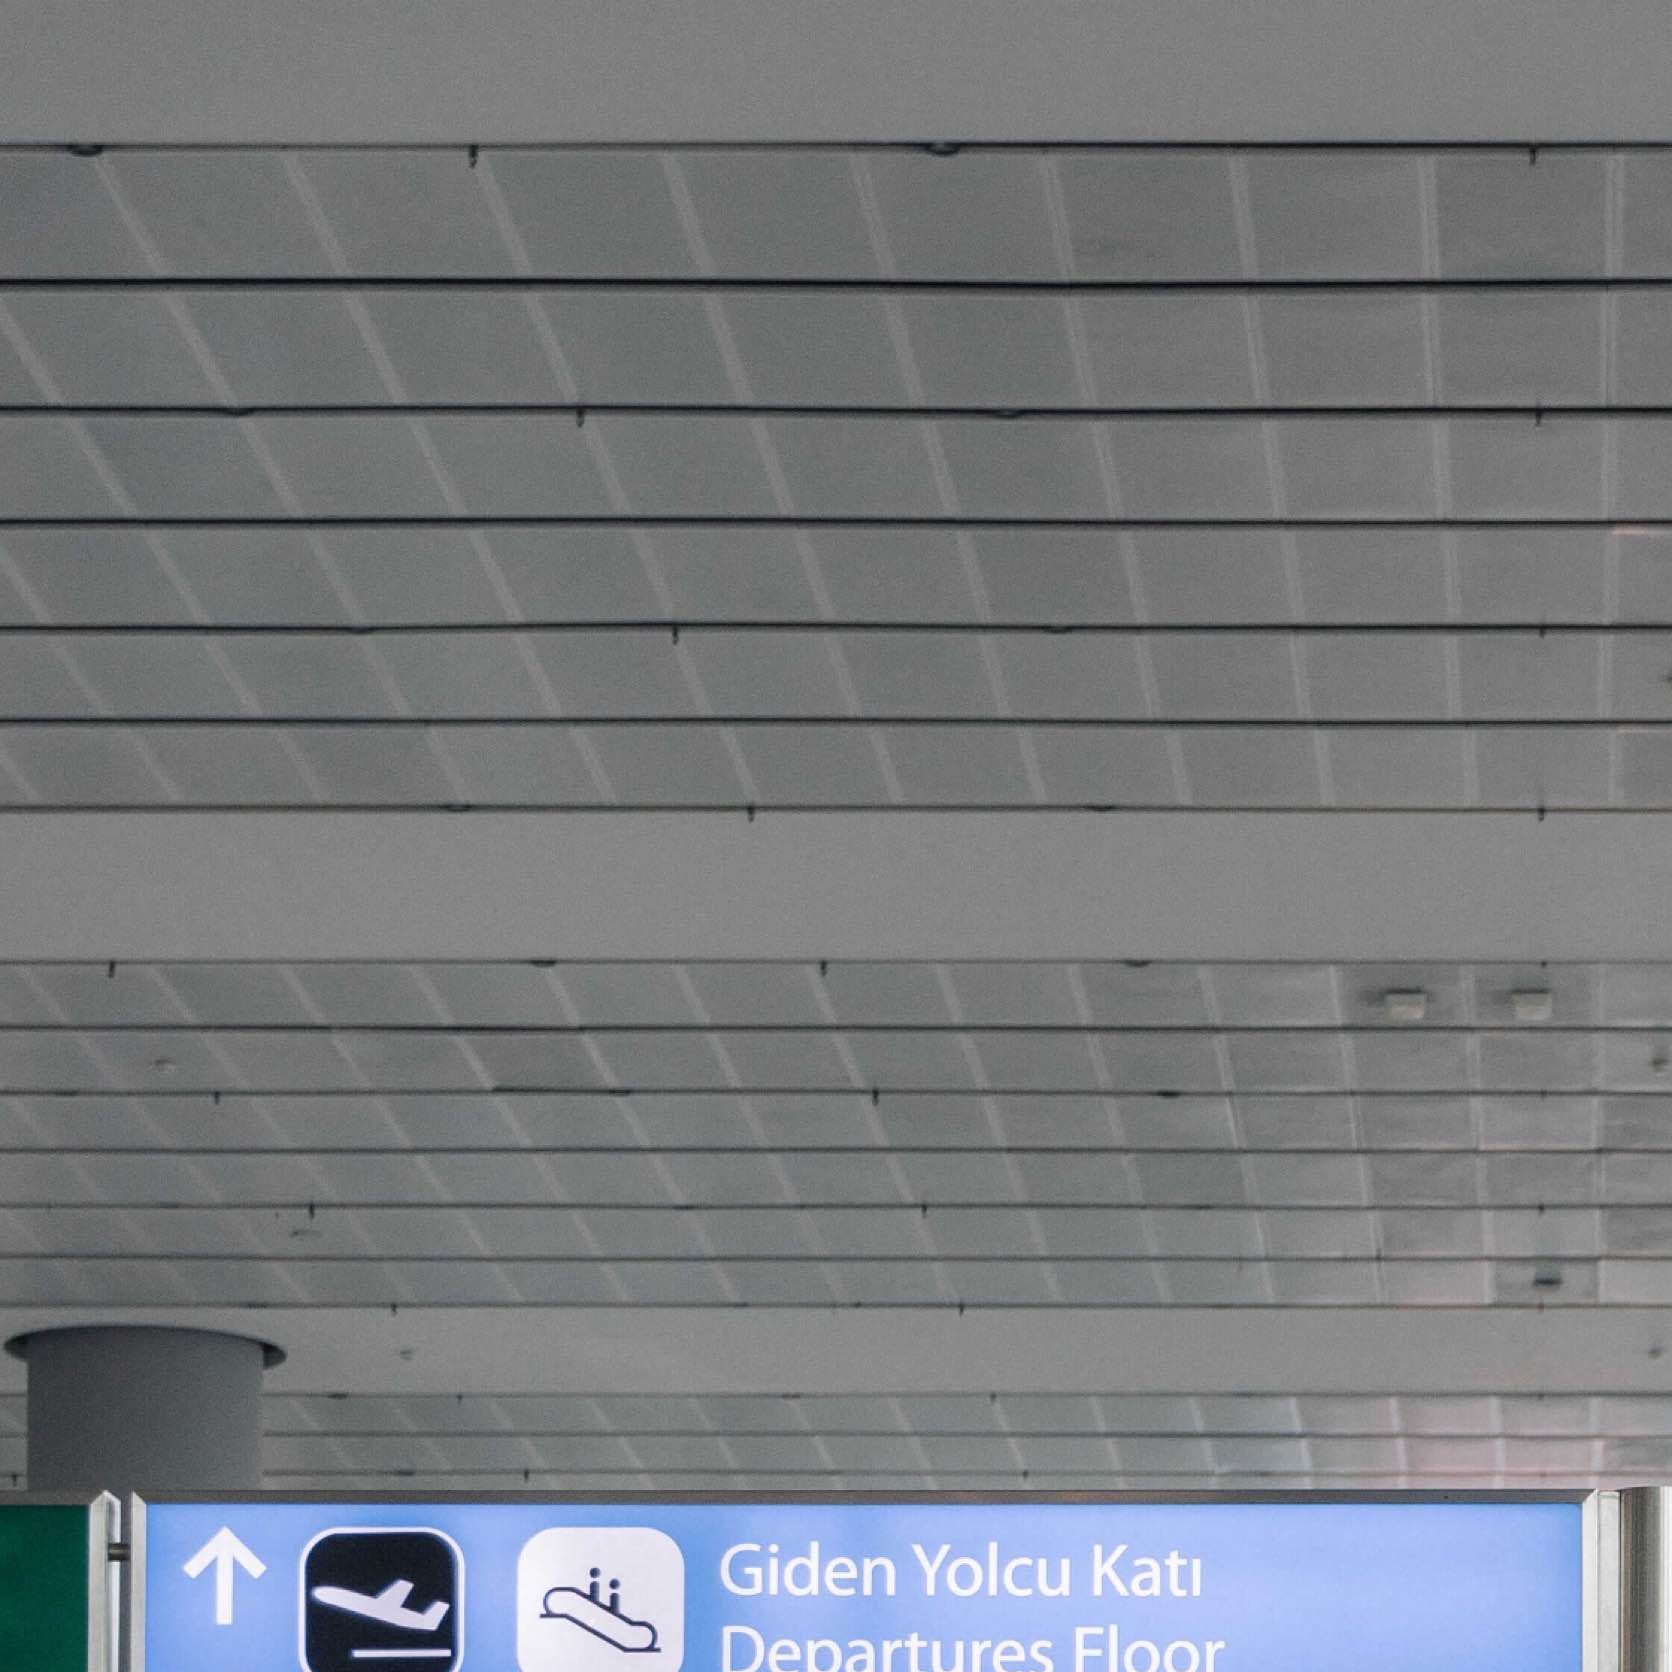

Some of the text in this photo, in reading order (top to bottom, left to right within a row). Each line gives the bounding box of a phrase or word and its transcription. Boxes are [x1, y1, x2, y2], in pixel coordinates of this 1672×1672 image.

[720, 1540, 1201, 1597] Giden Yolcu Katı
